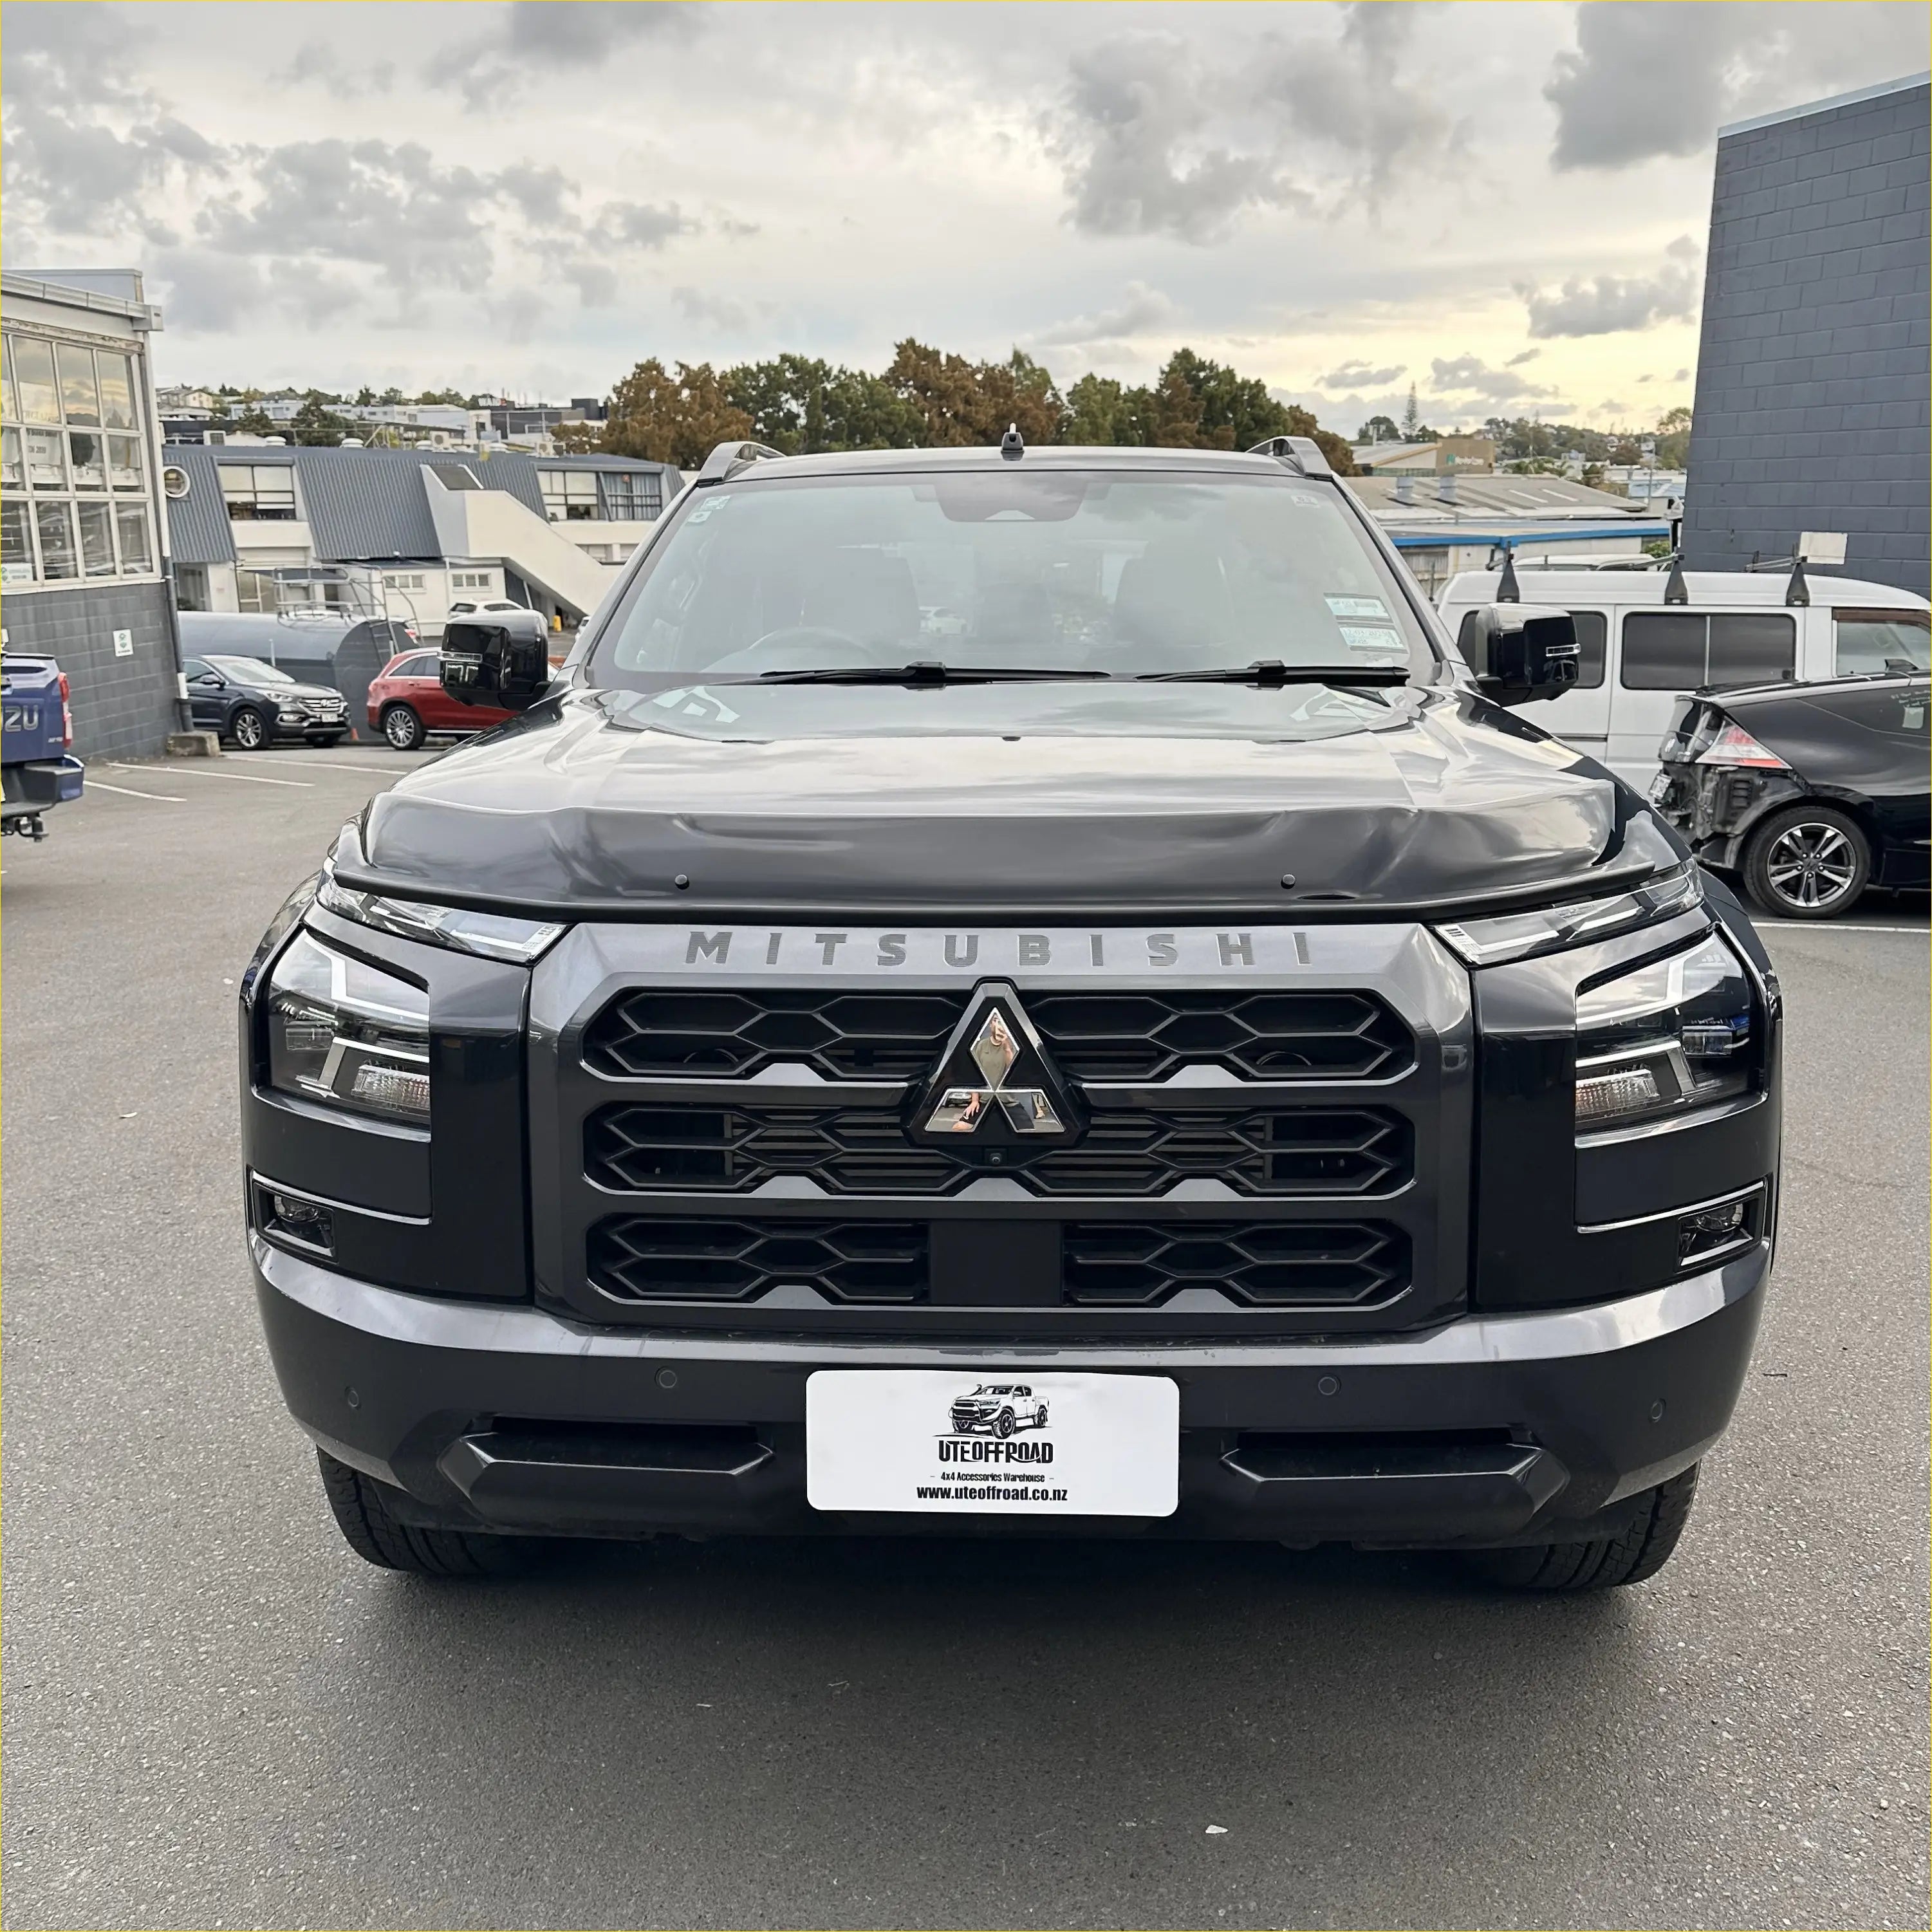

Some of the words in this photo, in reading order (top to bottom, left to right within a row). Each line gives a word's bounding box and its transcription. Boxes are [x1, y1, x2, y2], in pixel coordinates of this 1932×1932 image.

[0, 705, 39, 732] ZU
[685, 931, 1311, 967] MITSUBISHI
[941, 1472, 955, 1481] 4x4
[956, 1472, 1002, 1482] Accessories
[1003, 1472, 1045, 1483] Warehouse
[916, 1485, 1068, 1501] www.uteoffroad.co.nz
